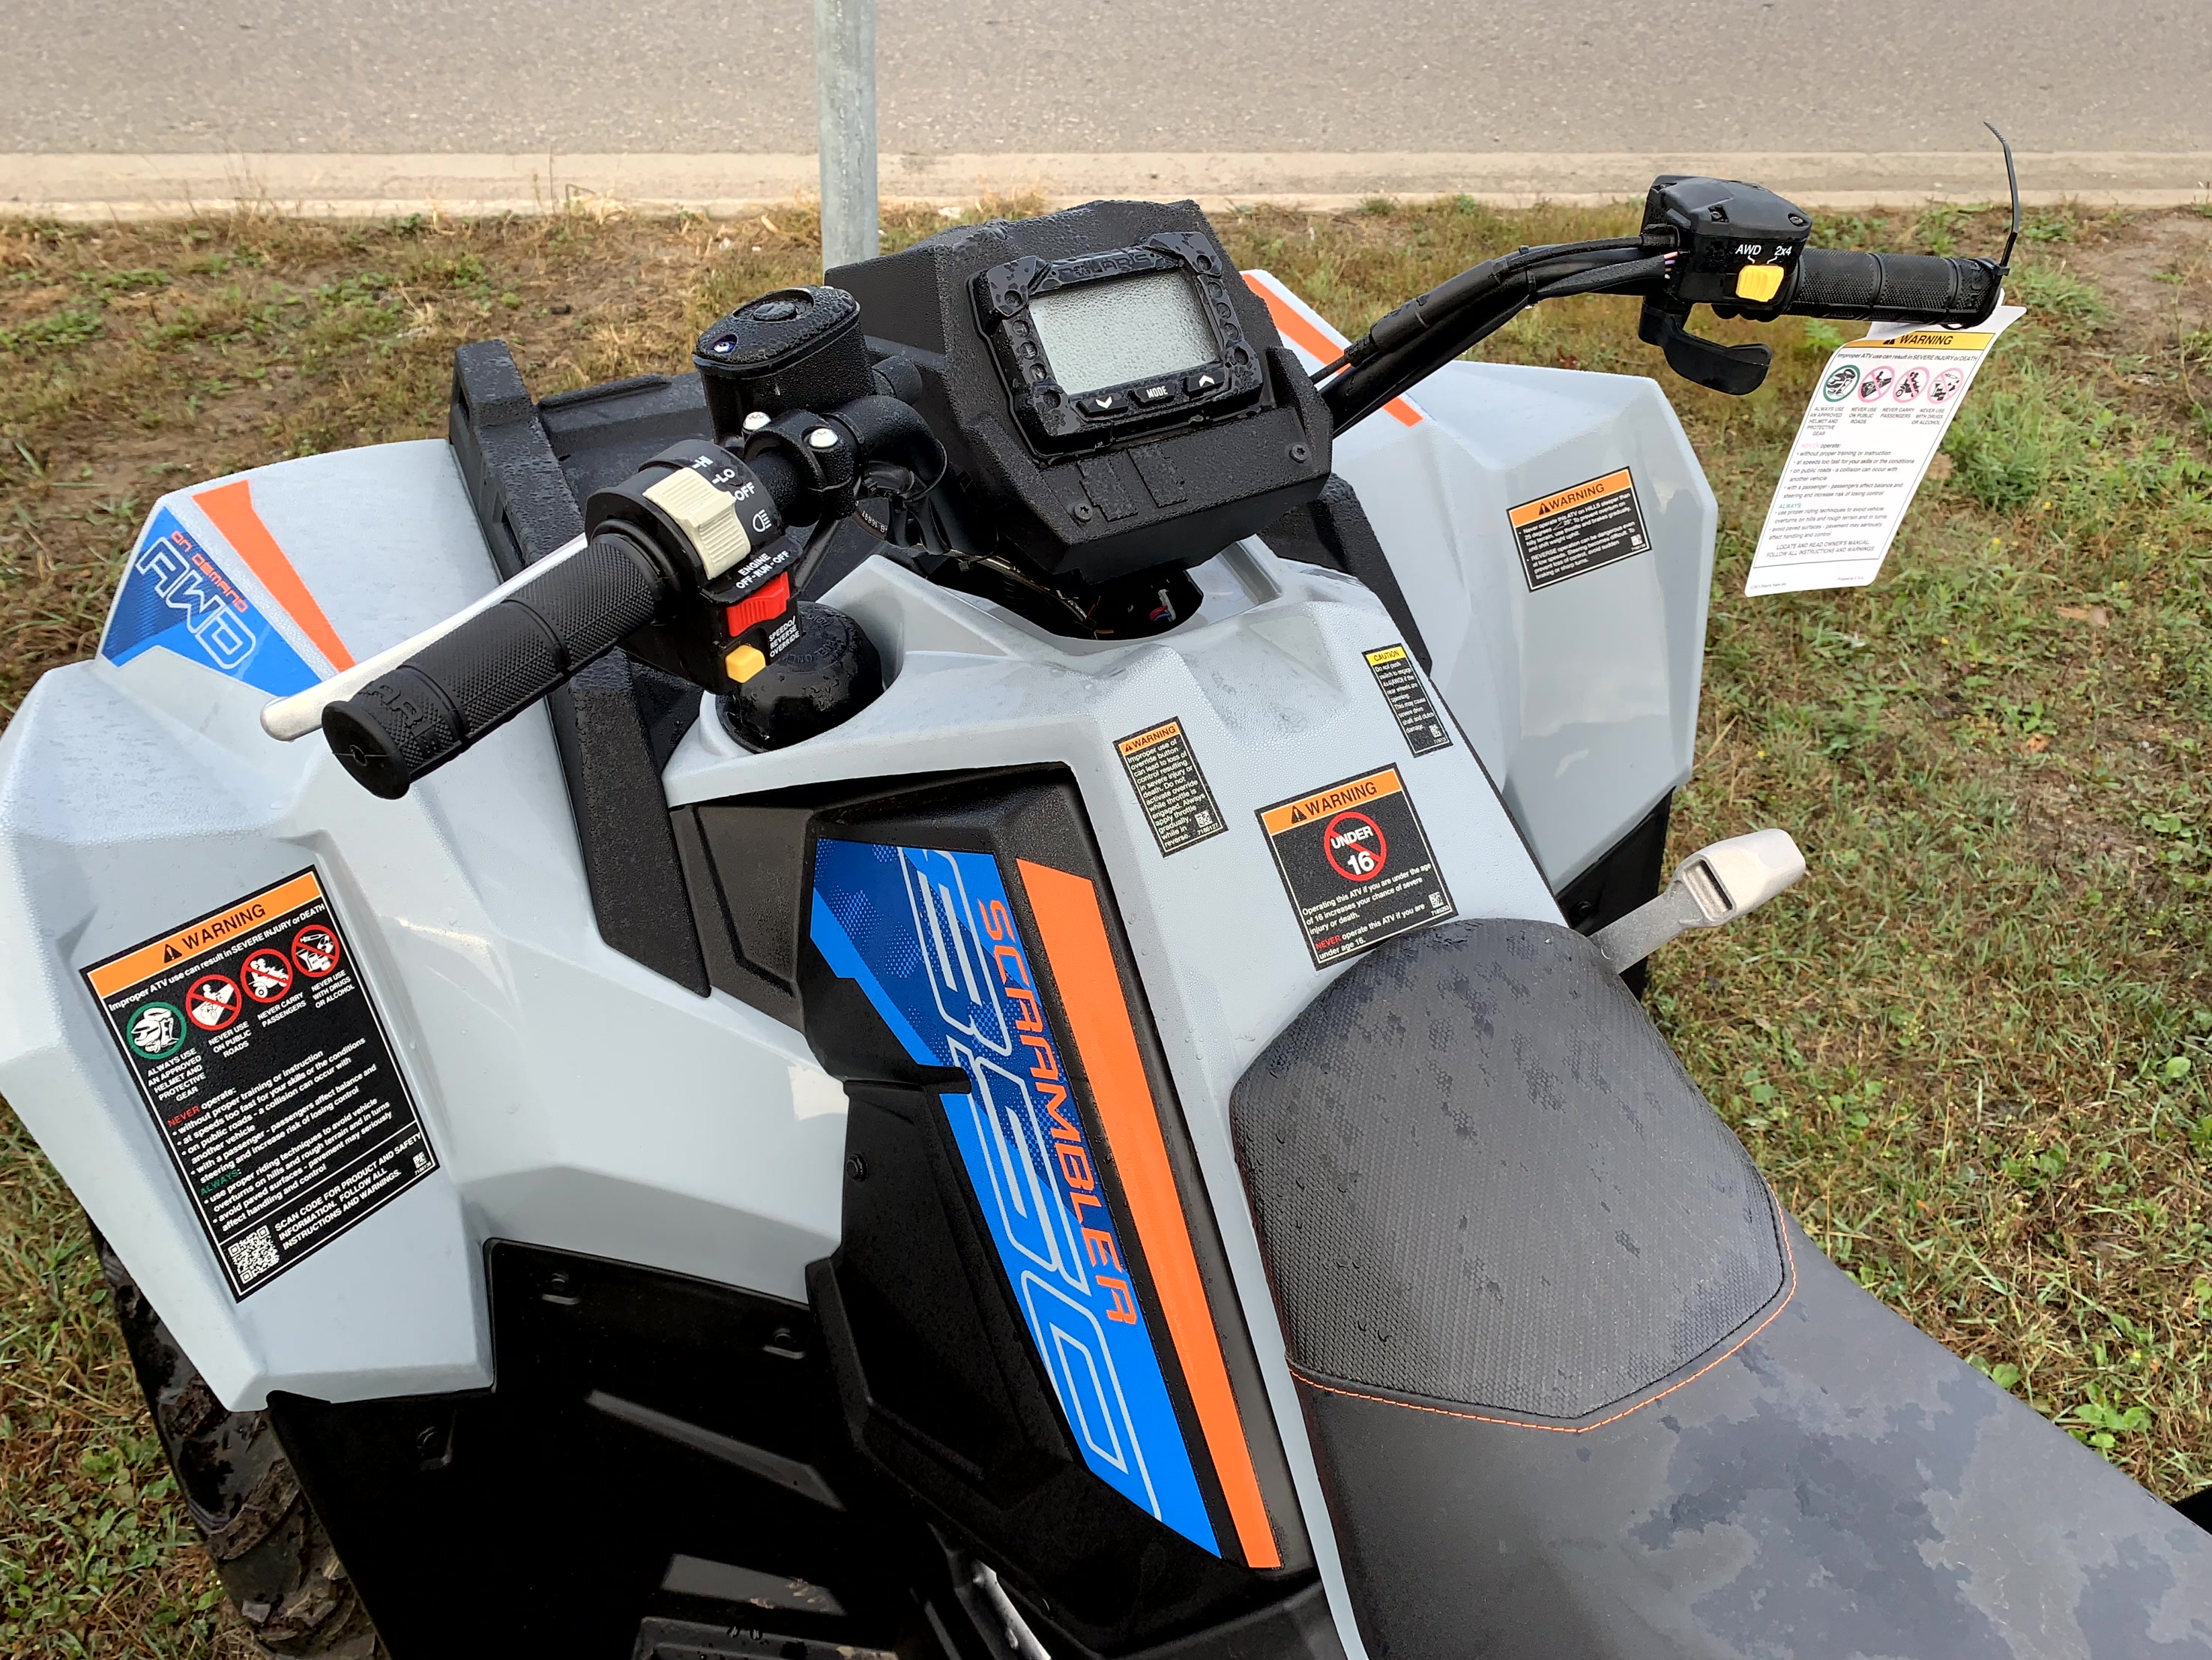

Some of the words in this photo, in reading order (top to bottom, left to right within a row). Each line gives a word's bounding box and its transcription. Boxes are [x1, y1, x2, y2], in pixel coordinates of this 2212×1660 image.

[1735, 244, 1762, 255] AWD
[1774, 246, 1792, 256] 2x4
[1899, 335, 1953, 345] WARNING
[1146, 385, 1168, 398] MODE
[718, 469, 735, 481] LO
[734, 482, 756, 501] OFF
[1549, 484, 1604, 509] WARNING
[171, 530, 192, 552] ON
[192, 553, 248, 613] DEMAND
[738, 553, 771, 576] ENGINE
[135, 536, 256, 670] AWD
[769, 616, 796, 641] SPEEDO/
[770, 625, 797, 650] REVERSE
[770, 631, 800, 658] OVERRIDE
[1374, 651, 1399, 661] CAUTION
[1132, 726, 1176, 748] WARNING
[1127, 748, 1157, 764] Improper
[1157, 742, 1169, 751] use
[1170, 738, 1178, 746] of
[1130, 756, 1157, 770] override
[1157, 747, 1179, 759] button
[1133, 769, 1146, 778] can
[1145, 762, 1160, 772] lead
[1166, 754, 1181, 763] loss
[1137, 770, 1160, 784] control
[1160, 760, 1188, 775] resulting
[1143, 787, 1164, 799] death.
[1163, 781, 1174, 790] Do
[1174, 776, 1186, 785] not
[1147, 776, 1168, 789] severe
[1167, 769, 1185, 780] injury
[1146, 791, 1172, 805] activate
[1172, 780, 1199, 794] override
[1148, 802, 1166, 812] while
[1166, 792, 1190, 805] throttle
[1305, 782, 1377, 816] WARNING
[1152, 802, 1182, 820] engaged.
[1183, 793, 1206, 807] Always
[1155, 815, 1173, 826] apply
[1173, 805, 1197, 818] throttle
[1158, 817, 1192, 834] gradually,
[1161, 829, 1180, 840] while
[1197, 823, 1218, 835] 7186127
[1330, 826, 1374, 849] UNDER
[1164, 834, 1191, 848] reverse.
[1347, 851, 1375, 875] 16
[1302, 899, 1336, 915] Operating
[1336, 894, 1349, 903] this
[1350, 888, 1362, 899] ATV
[1368, 882, 1381, 892] you
[1381, 878, 1392, 887] are
[1391, 871, 1409, 882] under
[1409, 867, 1420, 876] the
[1420, 863, 1432, 872] age
[1307, 917, 1314, 925] of
[1315, 913, 1324, 922] 16
[1323, 903, 1357, 918] increases
[1356, 897, 1371, 908] your
[1372, 888, 1395, 900] chance
[1395, 883, 1402, 891] of
[1402, 877, 1423, 889] severe
[182, 904, 266, 949] WARNING
[1309, 923, 1329, 935] injury
[1339, 912, 1360, 924] death.
[1316, 936, 1340, 948] NEVER
[1342, 926, 1368, 940] operate
[1368, 920, 1381, 930] this
[1382, 914, 1395, 925] ATV
[1401, 908, 1414, 918] you
[1414, 903, 1425, 912] are
[108, 988, 149, 1011] Improper
[150, 978, 168, 993] ATV
[168, 972, 184, 984] use
[184, 965, 201, 976] can
[200, 953, 224, 969] result
[231, 933, 265, 954] SEVERE
[263, 919, 292, 938] INJURY
[292, 916, 300, 924] or
[299, 903, 325, 921] DEATH
[1319, 947, 1339, 960] under
[1341, 942, 1354, 951] age
[1354, 936, 1366, 945] 16.
[311, 977, 333, 992] NEVER
[332, 969, 346, 981] USE
[313, 988, 330, 1000] WITH
[329, 976, 351, 992] DRUGS
[257, 1004, 281, 1020] NEVER
[281, 992, 303, 1008] CARRY
[316, 999, 326, 1008] OR
[326, 984, 355, 1003] ALCOHOL
[262, 1000, 307, 1027] PASSENGERS
[208, 1029, 234, 1046] NEVER
[233, 1021, 250, 1032] USE
[213, 1043, 226, 1053] ON
[225, 1029, 252, 1047] PUBLIC
[148, 1056, 181, 1077] ALWAYS
[180, 1047, 197, 1059] USE
[223, 1041, 250, 1058] ROADS
[148, 1077, 160, 1087] AN
[161, 1055, 202, 1080] APPROVED
[154, 1073, 185, 1093] HELMET
[187, 1065, 203, 1077] AND
[158, 1072, 206, 1101] PROTECTIVE
[176, 1086, 199, 1101] GEAR
[178, 1112, 212, 1134] without
[211, 1096, 240, 1118] proper
[241, 1080, 273, 1100] training
[273, 1074, 282, 1083] or
[282, 1050, 324, 1077] instruction
[168, 1107, 200, 1126] NEVER
[201, 1087, 237, 1110] operate:
[977, 897, 1139, 1326] SCRAMBLER
[201, 1169, 242, 1196] ALWAYS:
[274, 1212, 300, 1231] SCAN
[300, 1197, 324, 1215] CODE
[323, 1185, 341, 1201] FOR
[341, 1161, 377, 1189] PRODUCT
[379, 1151, 394, 1166] AND
[394, 1132, 421, 1155] SAFETY
[898, 846, 1161, 1521] 850
[279, 1200, 337, 1241] INFORMATION.
[339, 1176, 372, 1202] FOLLOW
[373, 1167, 388, 1181] ALL
[283, 1208, 343, 1250] INSTRUCTIONS
[343, 1197, 360, 1212] AND
[359, 1170, 402, 1200] WARNINGS.
